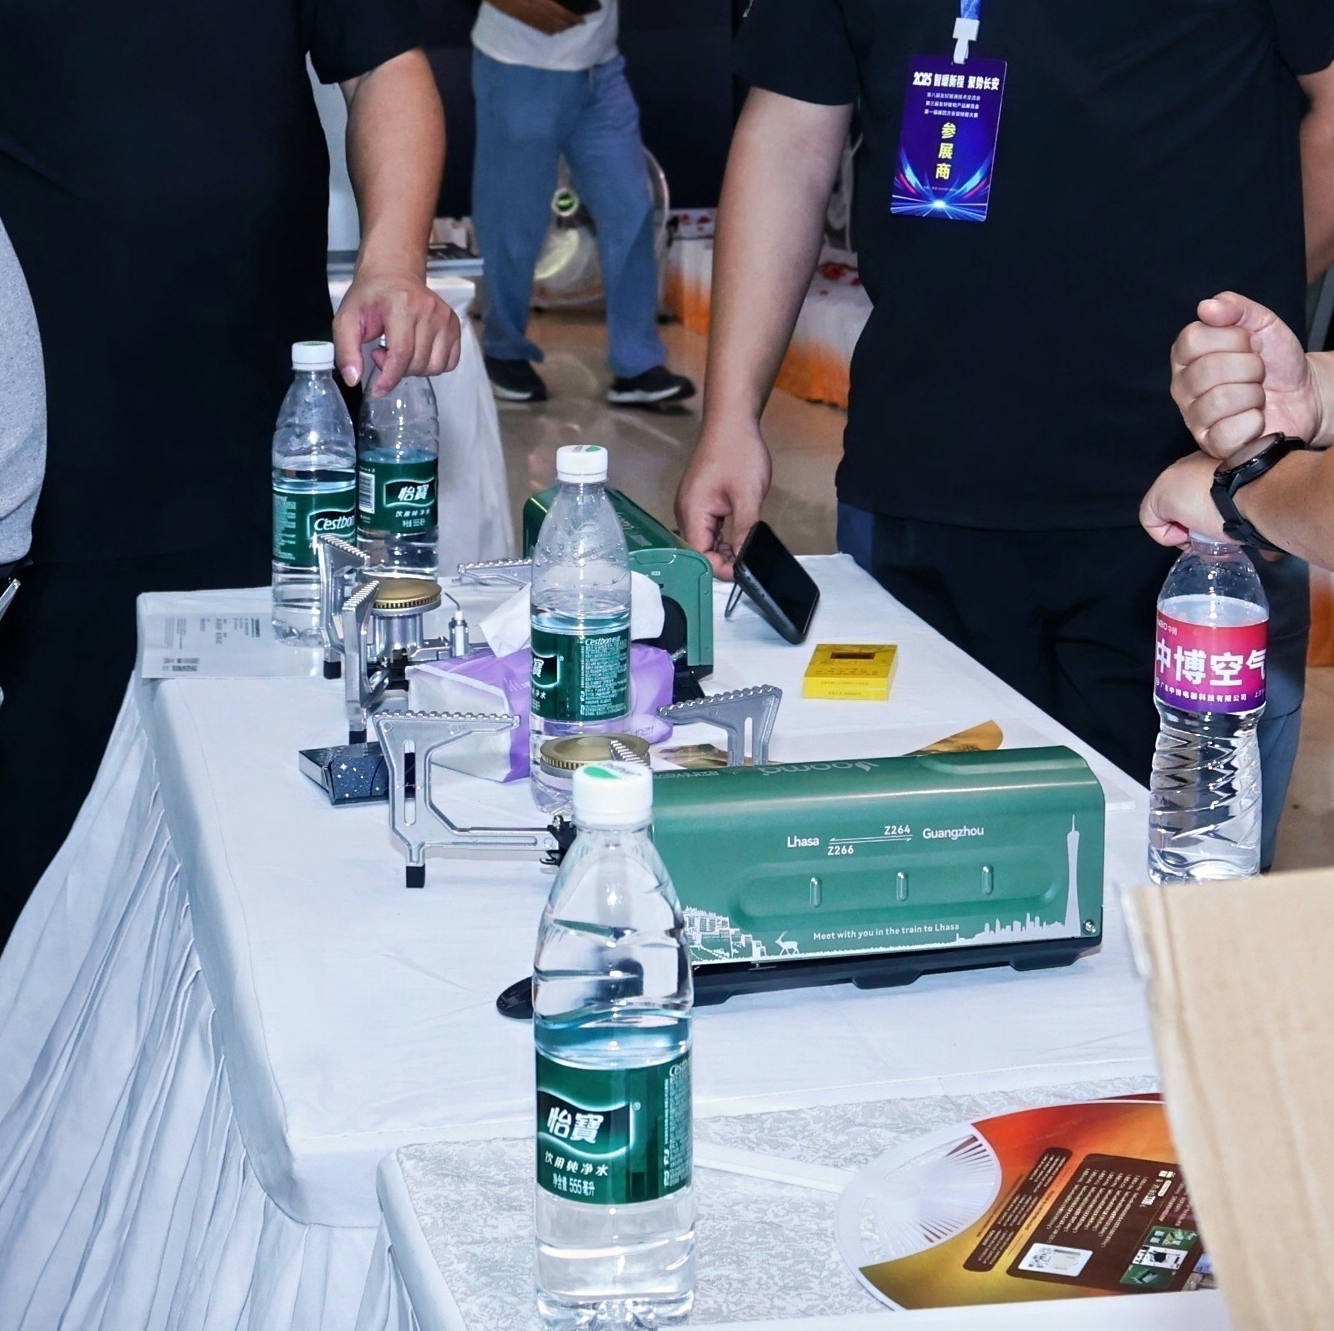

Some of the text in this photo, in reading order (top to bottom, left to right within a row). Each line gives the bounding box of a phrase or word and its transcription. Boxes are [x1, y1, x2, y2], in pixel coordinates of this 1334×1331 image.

[912, 71, 933, 86] 2025
[935, 122, 957, 180] 参展商
[787, 826, 985, 848] Lhasa Guangzhou
[884, 825, 911, 835] Z264
[827, 845, 854, 856] Z266
[813, 923, 959, 940] Meet with you in the train to Lhasa
[545, 1151, 609, 1177] 饮用纯净水
